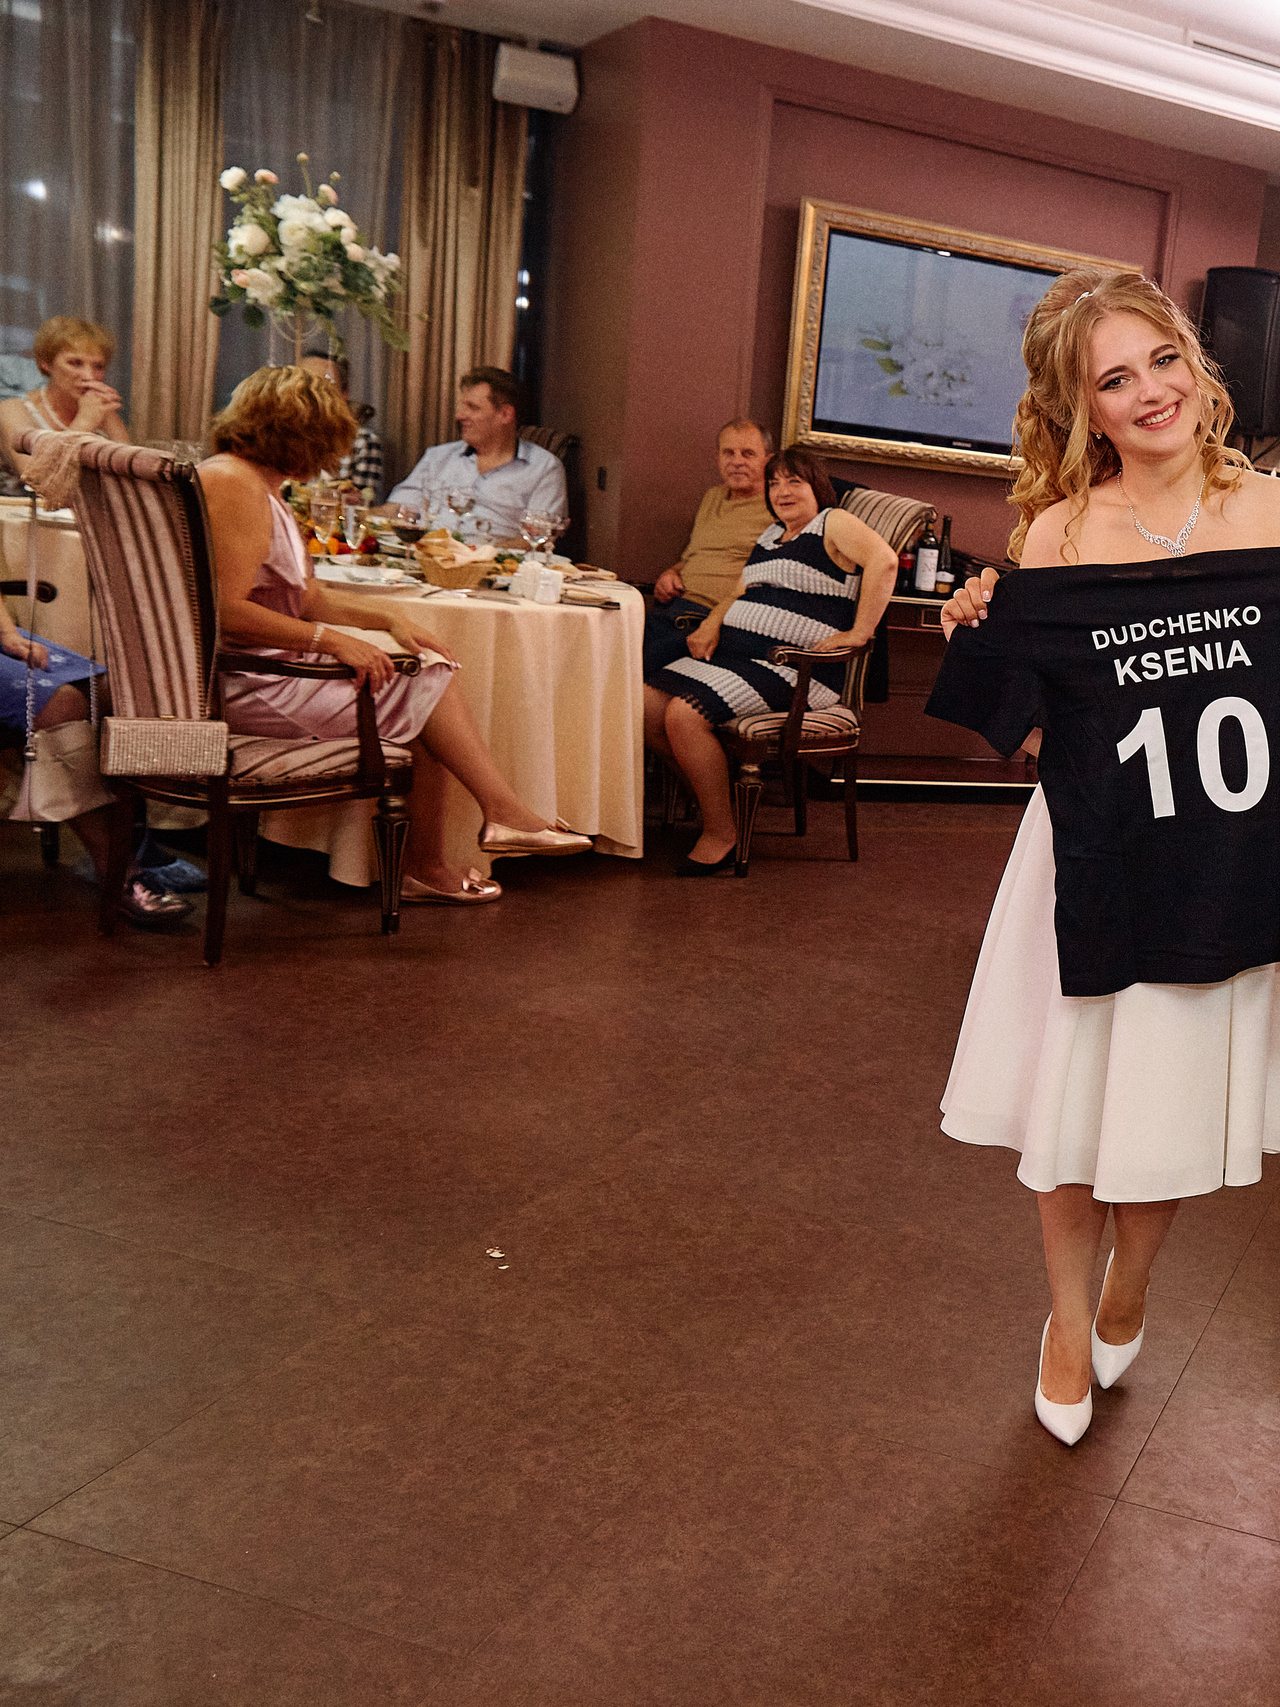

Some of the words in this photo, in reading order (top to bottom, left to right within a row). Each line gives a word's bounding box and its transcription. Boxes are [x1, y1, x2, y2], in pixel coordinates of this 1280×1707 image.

[1091, 605, 1262, 650] DUDCHENKO
[1113, 639, 1253, 686] KSENIA
[1116, 696, 1270, 819] 10
